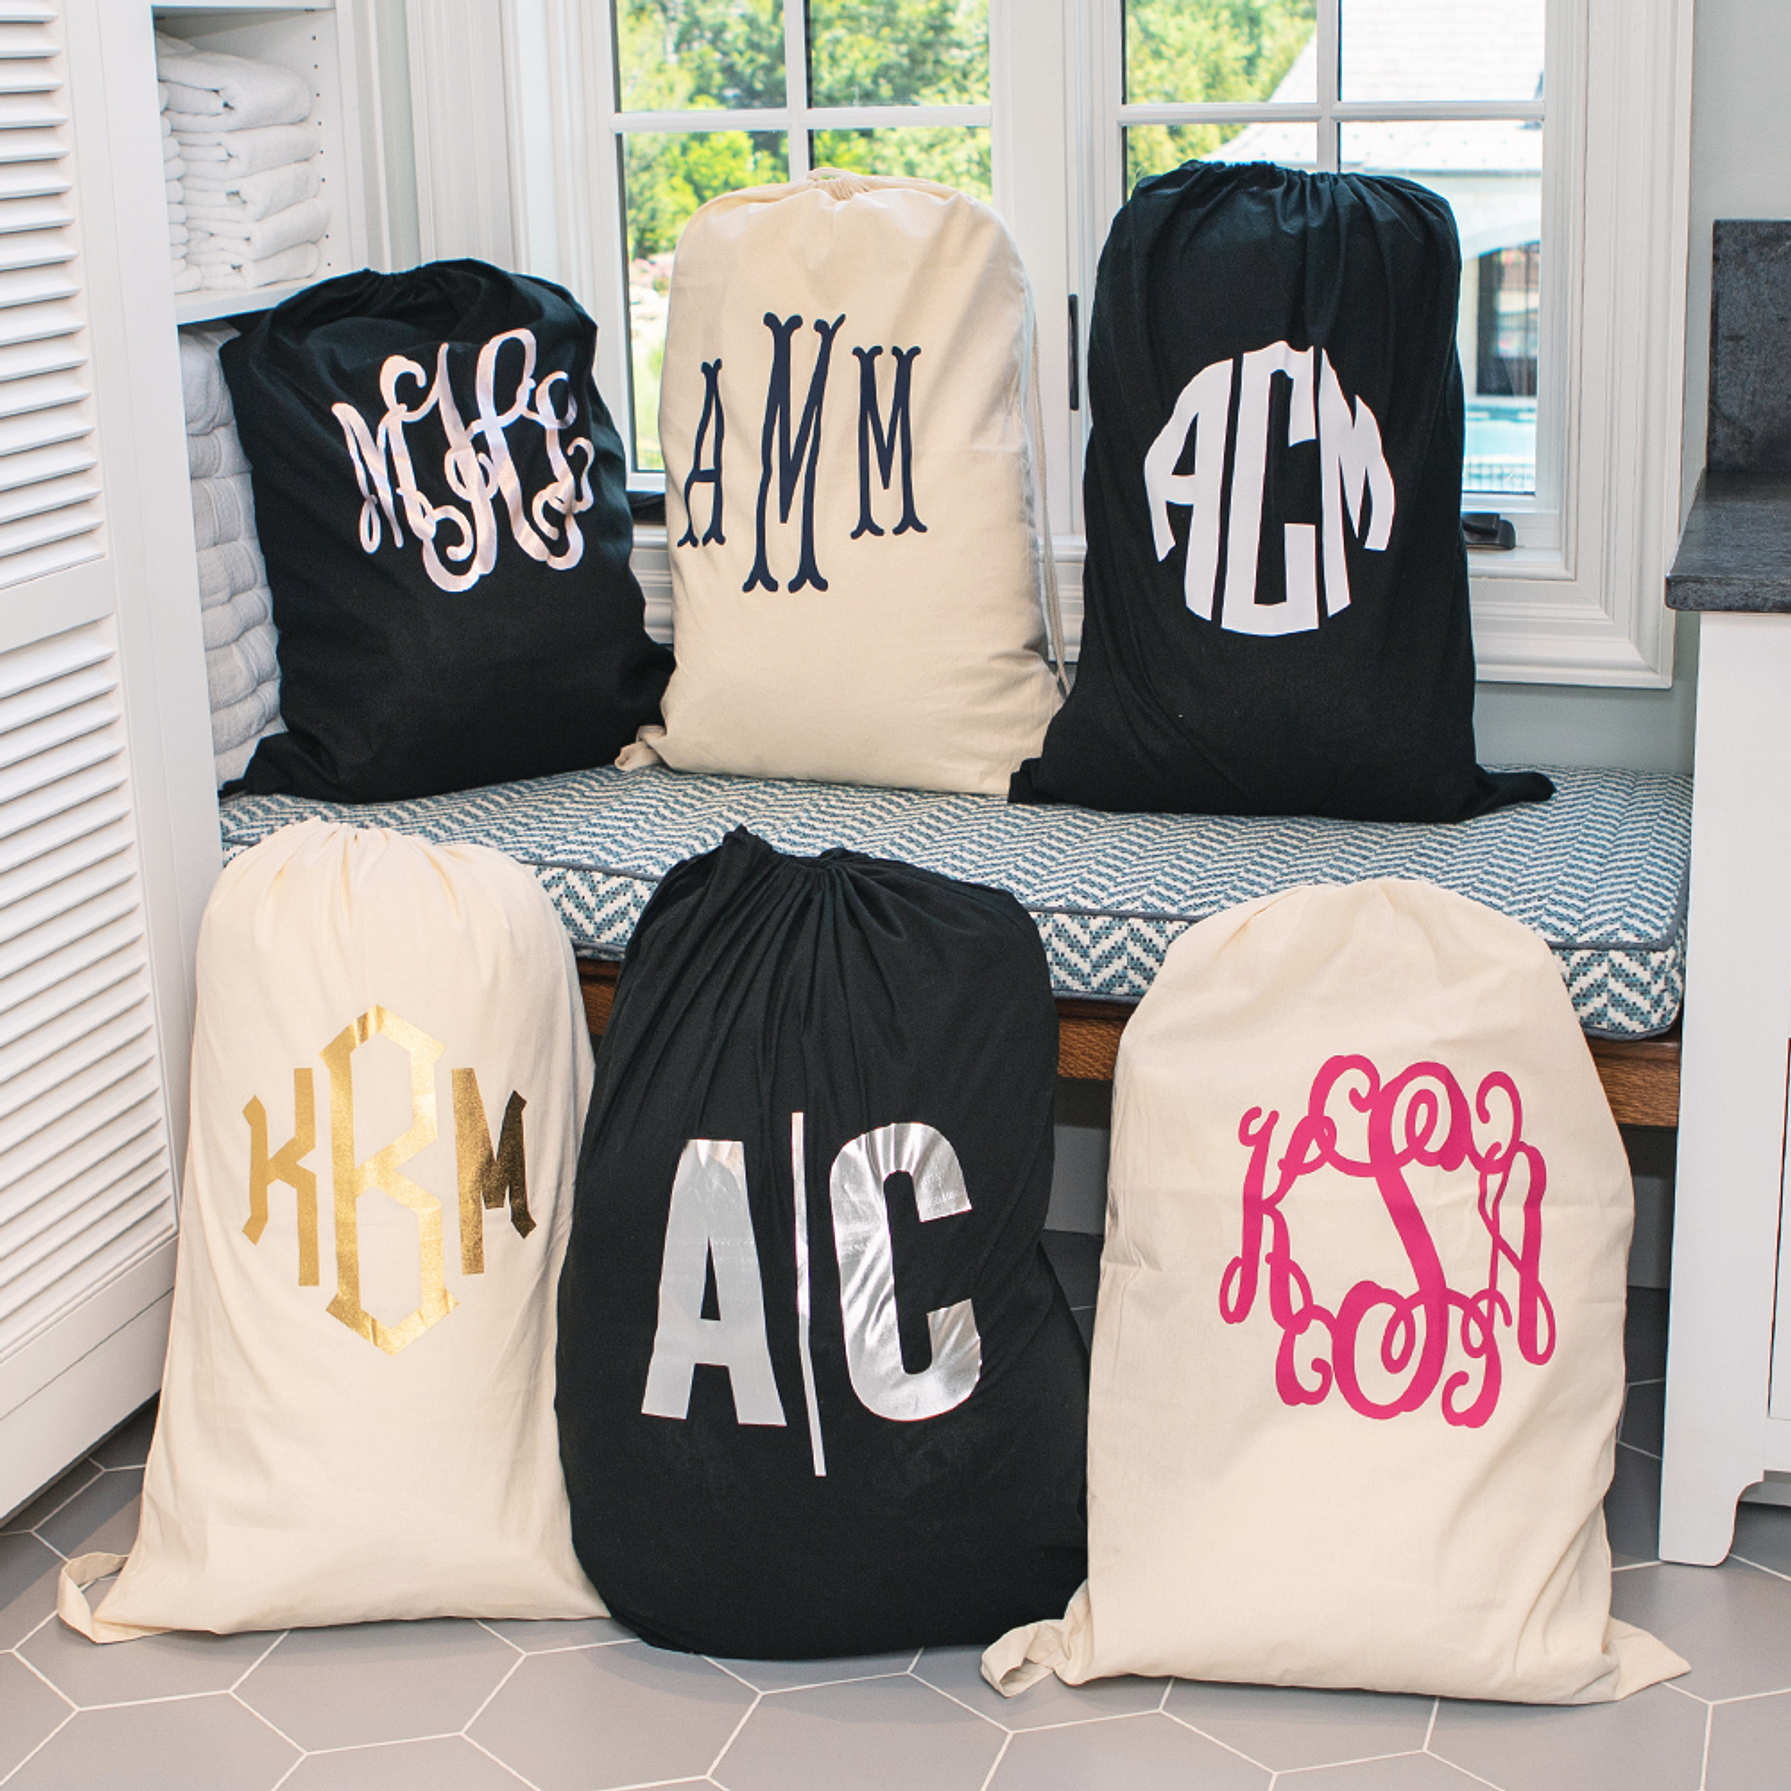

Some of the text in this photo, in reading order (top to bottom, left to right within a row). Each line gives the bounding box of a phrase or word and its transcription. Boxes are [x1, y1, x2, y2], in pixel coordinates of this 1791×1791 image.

[677, 312, 928, 592] AMM
[1144, 340, 1397, 637] ACM
[241, 1004, 537, 1355] KBM
